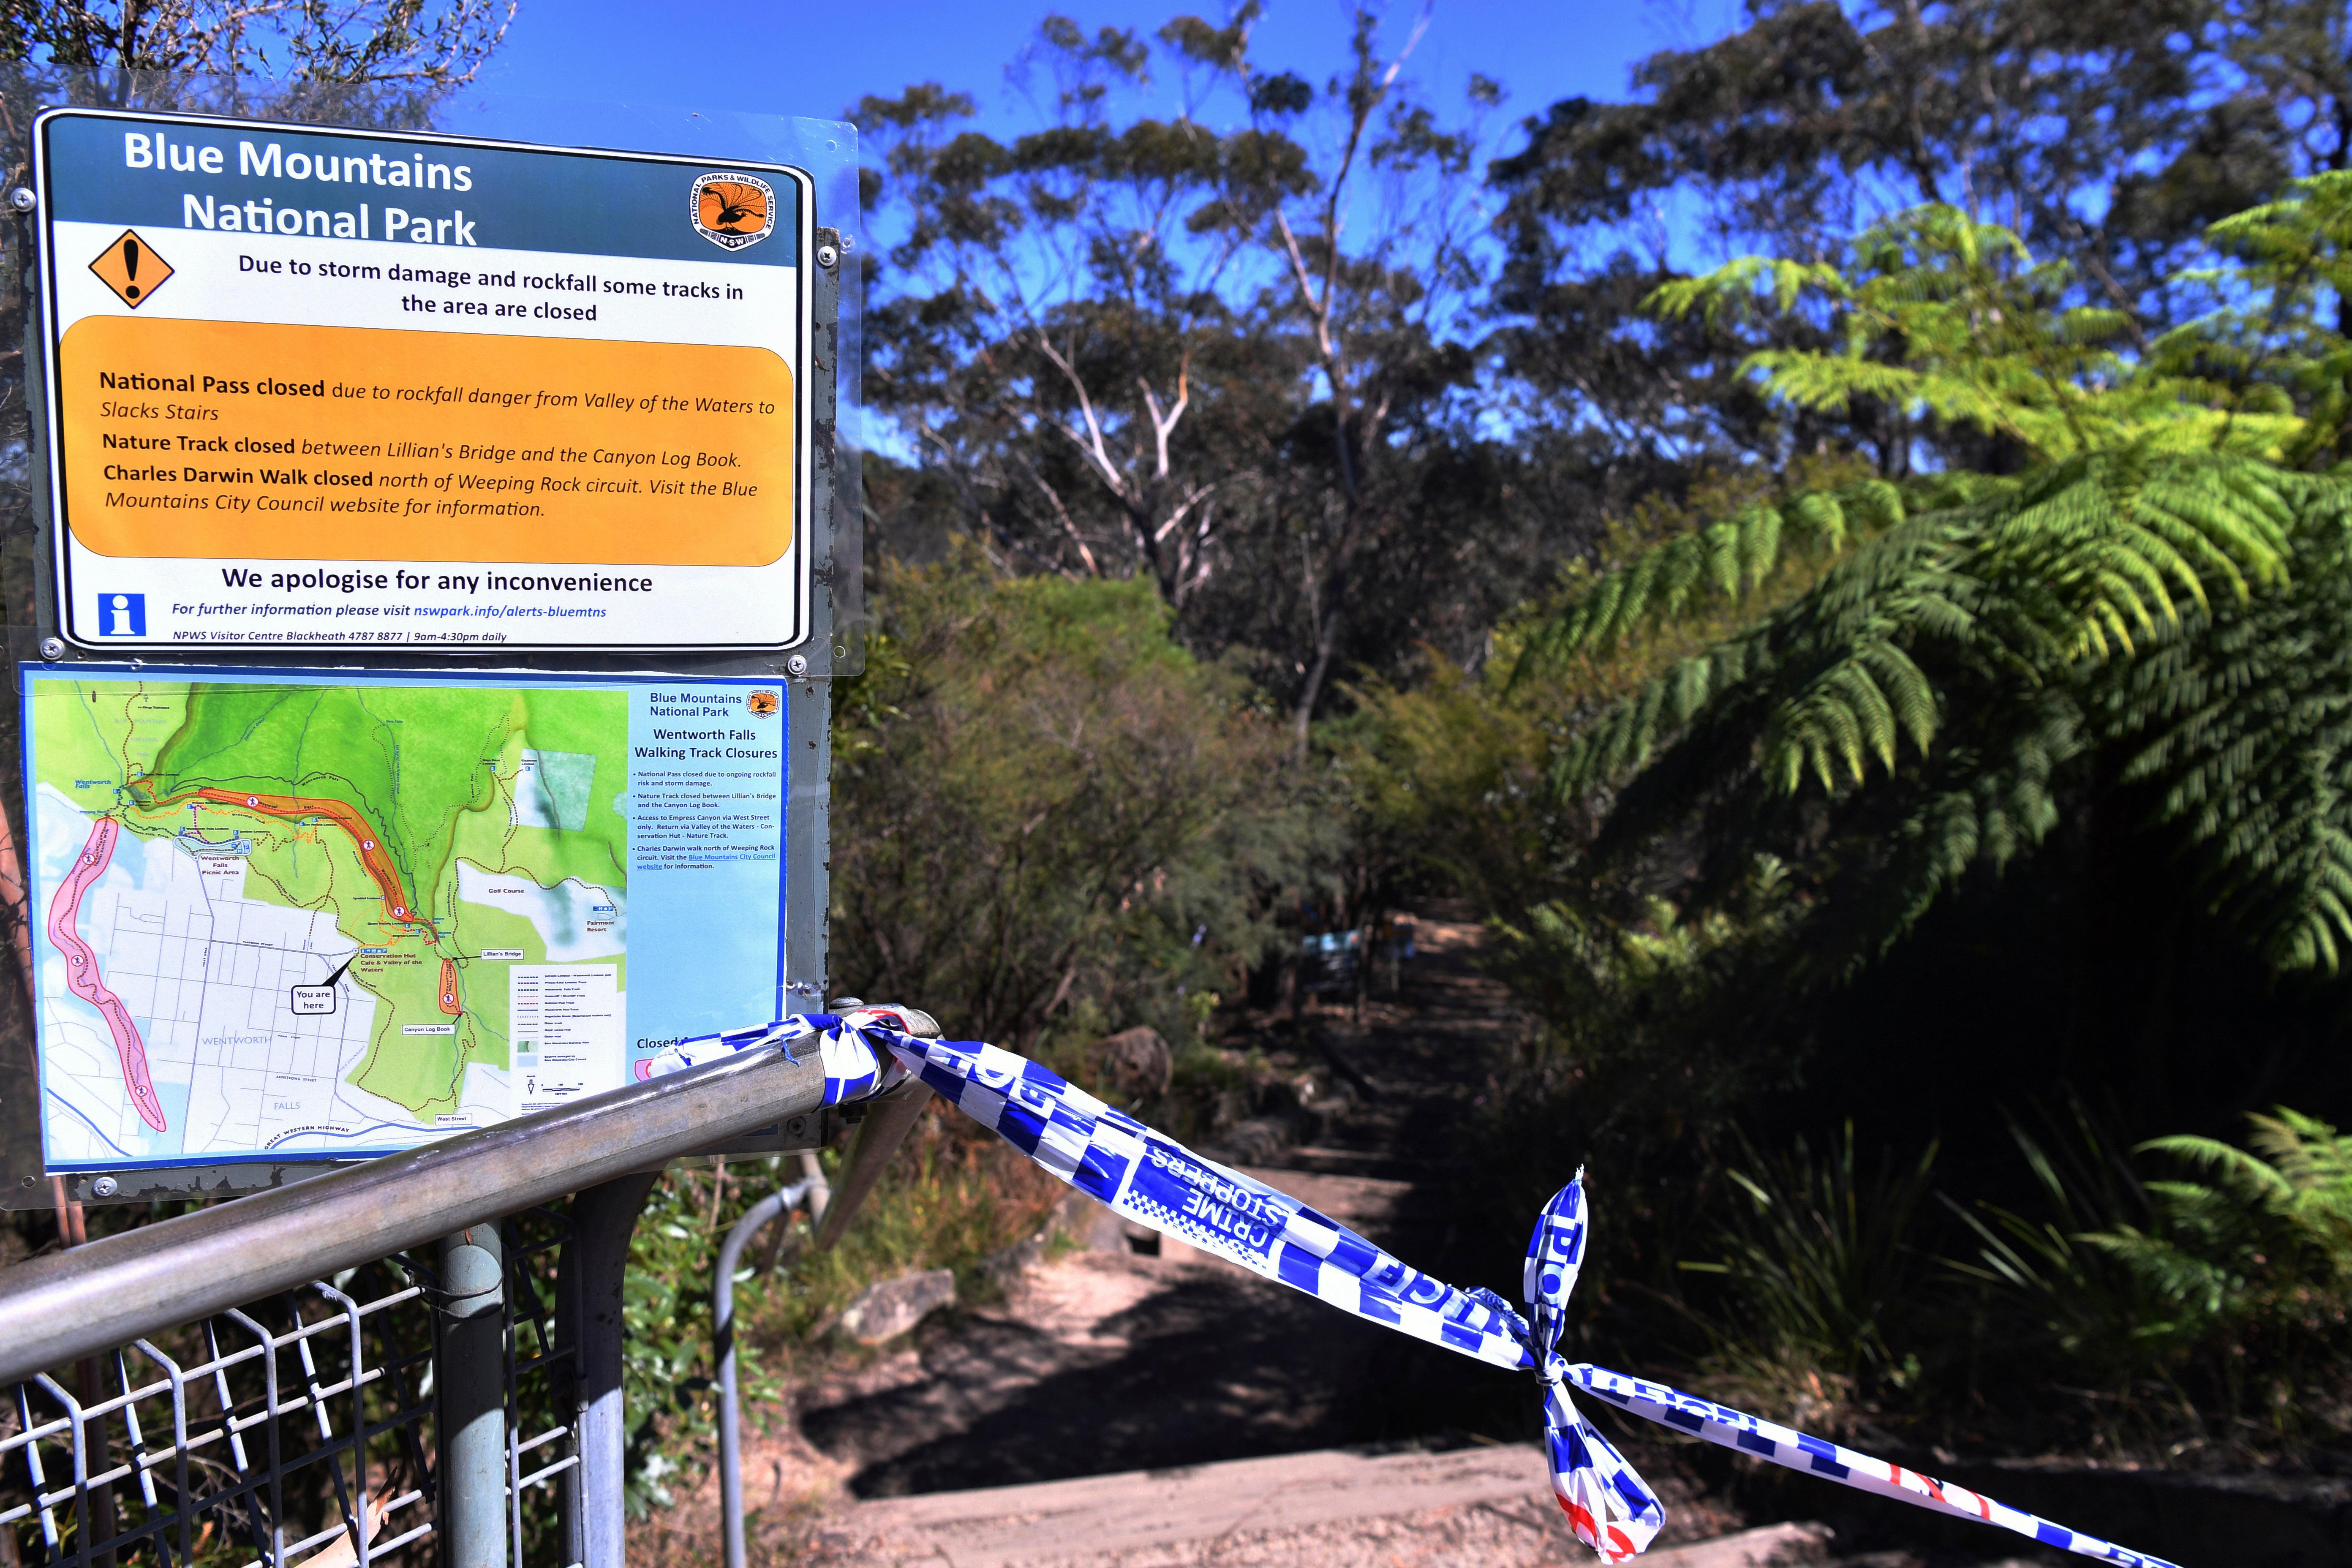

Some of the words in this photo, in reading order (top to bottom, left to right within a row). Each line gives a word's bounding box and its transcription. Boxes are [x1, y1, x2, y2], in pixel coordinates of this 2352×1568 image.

[125, 133, 223, 173] Blue
[240, 142, 472, 191] Mountains
[692, 183, 701, 224] NATIONAL
[701, 174, 728, 183] PARKS
[737, 176, 770, 193] WILDLIFE
[184, 194, 368, 239] National
[386, 207, 477, 245] Park
[240, 255, 281, 273] Due
[289, 259, 311, 275] to
[319, 262, 380, 279] storm
[389, 264, 471, 288] damage
[479, 271, 515, 287] and
[524, 273, 596, 291] rockfall
[604, 281, 656, 295] some
[662, 282, 719, 298] tracks
[727, 284, 742, 299] in
[402, 294, 436, 312] the
[444, 302, 487, 315] area
[495, 304, 526, 317] are
[534, 302, 596, 321] closed
[101, 373, 194, 392] National
[204, 376, 249, 394] Pass
[257, 378, 324, 396] closed
[333, 383, 365, 398] due
[373, 386, 389, 399] to
[397, 386, 463, 405] rockfall
[469, 388, 531, 407] danger
[534, 391, 577, 408] from
[585, 393, 634, 411] Valley
[640, 395, 658, 413] of
[662, 396, 689, 411] the
[696, 398, 753, 413] Waters
[760, 402, 774, 414] to
[101, 402, 158, 418] Slacks
[166, 405, 218, 420] Stairs
[103, 434, 170, 450] Nature
[177, 436, 228, 452] Track
[235, 437, 294, 453] closed
[302, 439, 380, 456] between
[388, 442, 452, 458] Lillian's
[460, 445, 515, 463] Bridge
[522, 447, 554, 461] and
[561, 448, 587, 462] the
[594, 449, 655, 467] Canyon
[662, 452, 690, 468] Log
[697, 453, 740, 467] Book.
[105, 465, 176, 481] Charles
[184, 468, 253, 483] Darwin
[260, 469, 308, 485] Walk
[314, 470, 372, 486] closed
[380, 473, 427, 487] north
[435, 474, 454, 492] of
[459, 475, 534, 493] Weeping
[541, 477, 580, 491] Rock
[587, 478, 641, 493] circuit.
[651, 480, 685, 494] Visit
[691, 481, 716, 495] the
[723, 482, 757, 496] Blue
[106, 493, 208, 509] Mountains
[216, 495, 250, 513] City
[257, 496, 324, 511] Council
[331, 498, 399, 513] website
[403, 498, 431, 516] for
[437, 500, 543, 517] information.
[222, 569, 262, 587] We
[272, 569, 387, 593] apologise
[396, 570, 430, 589] for
[438, 576, 479, 594] any
[488, 572, 652, 591] inconvenience
[172, 604, 194, 614] For
[197, 603, 247, 616] further
[251, 604, 332, 617] information
[336, 604, 378, 618] please
[384, 605, 410, 615] visit
[414, 605, 606, 618] nswpark.info/alerts-bluemtns
[211, 632, 245, 640] Visitor
[287, 632, 345, 640] Blackheath
[414, 633, 478, 642] 9am-4:30pm
[482, 633, 506, 642] daily
[651, 693, 677, 702] Blue
[681, 694, 741, 703] Mountains
[651, 706, 699, 716] National
[703, 707, 729, 716] Park
[653, 729, 724, 739] Wentworth
[730, 730, 755, 740] Falls
[635, 747, 686, 760] Walking
[689, 747, 721, 757] Track
[726, 748, 777, 758] Closures
[202, 1036, 272, 1045] WENTWORTH
[1151, 1146, 1285, 1227] STOPPERS
[1182, 1190, 1269, 1247] CRIME
